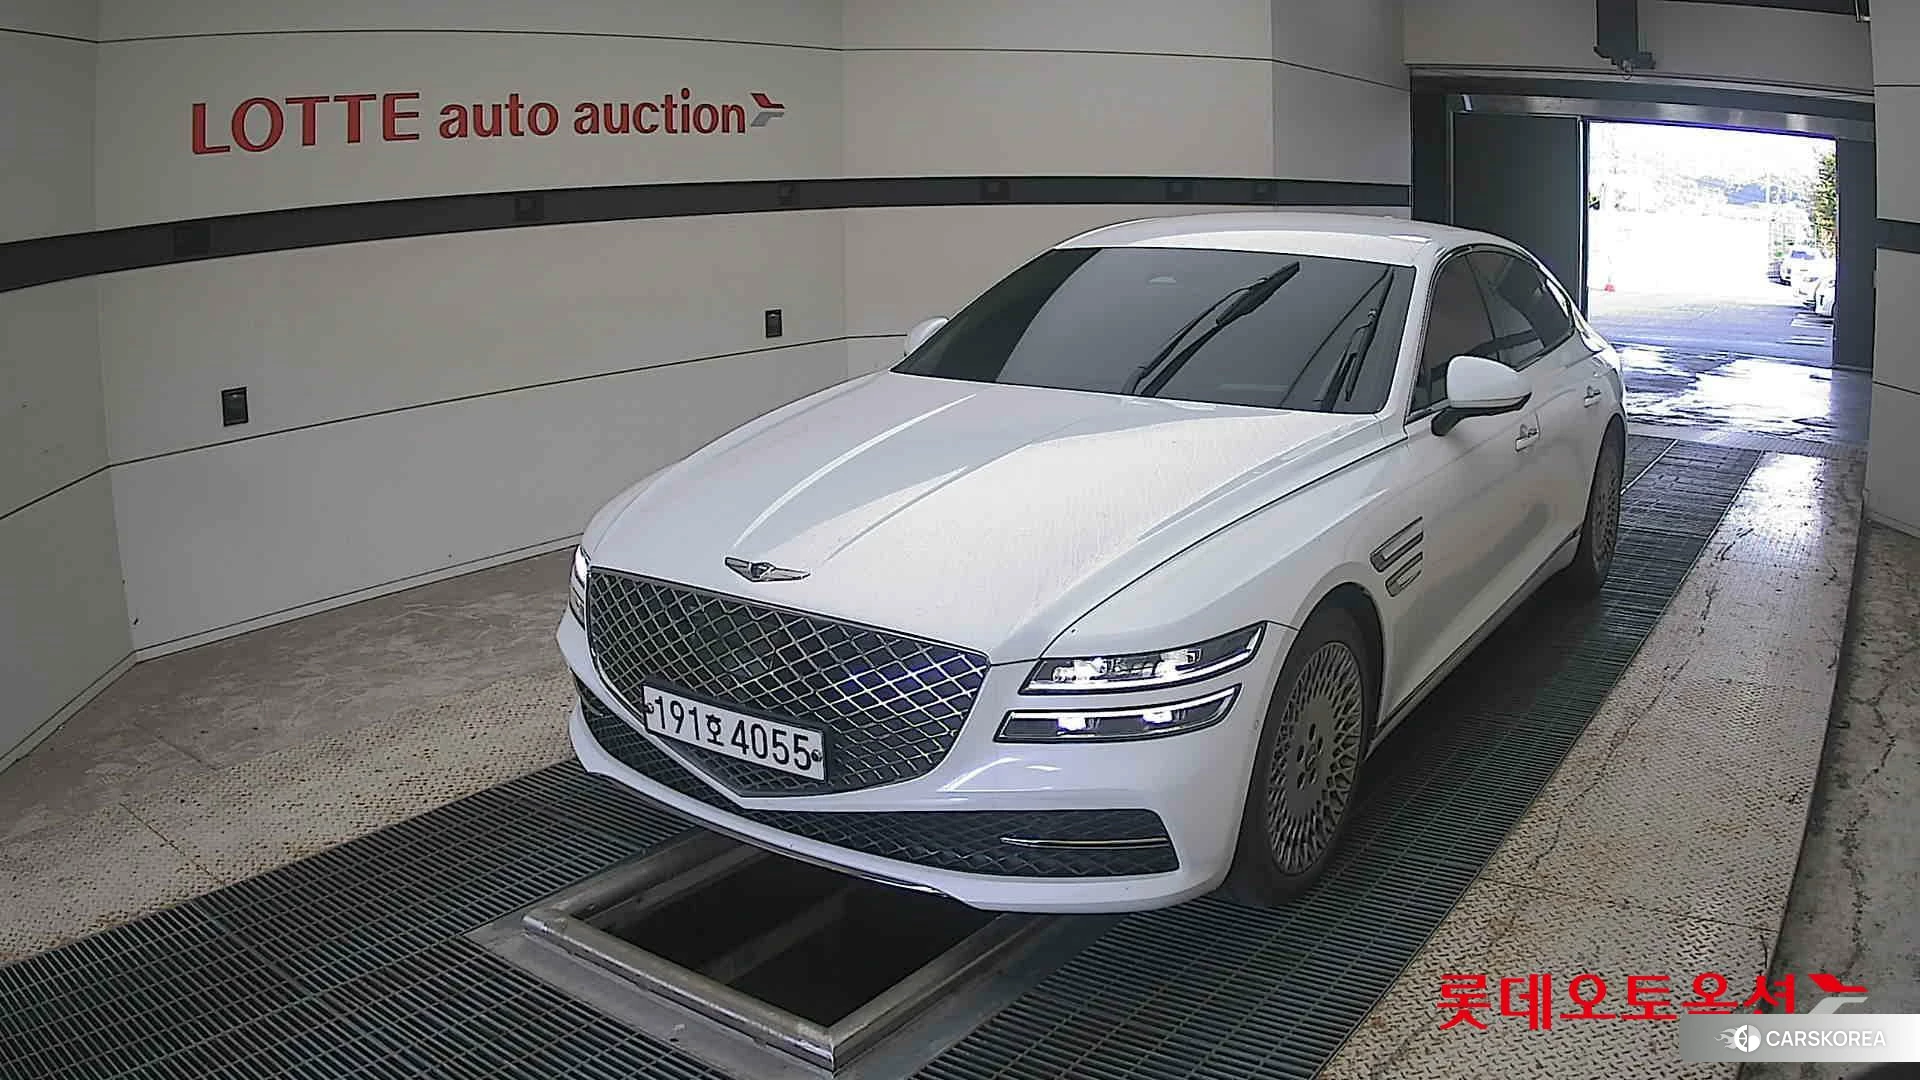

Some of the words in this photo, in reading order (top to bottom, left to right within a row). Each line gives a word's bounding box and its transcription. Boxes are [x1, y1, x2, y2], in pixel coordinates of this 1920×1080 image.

[191, 92, 420, 155] LOTTE
[439, 93, 559, 139] auto
[573, 87, 746, 135] auction
[654, 696, 725, 747] 191호
[731, 719, 812, 771] 4055
